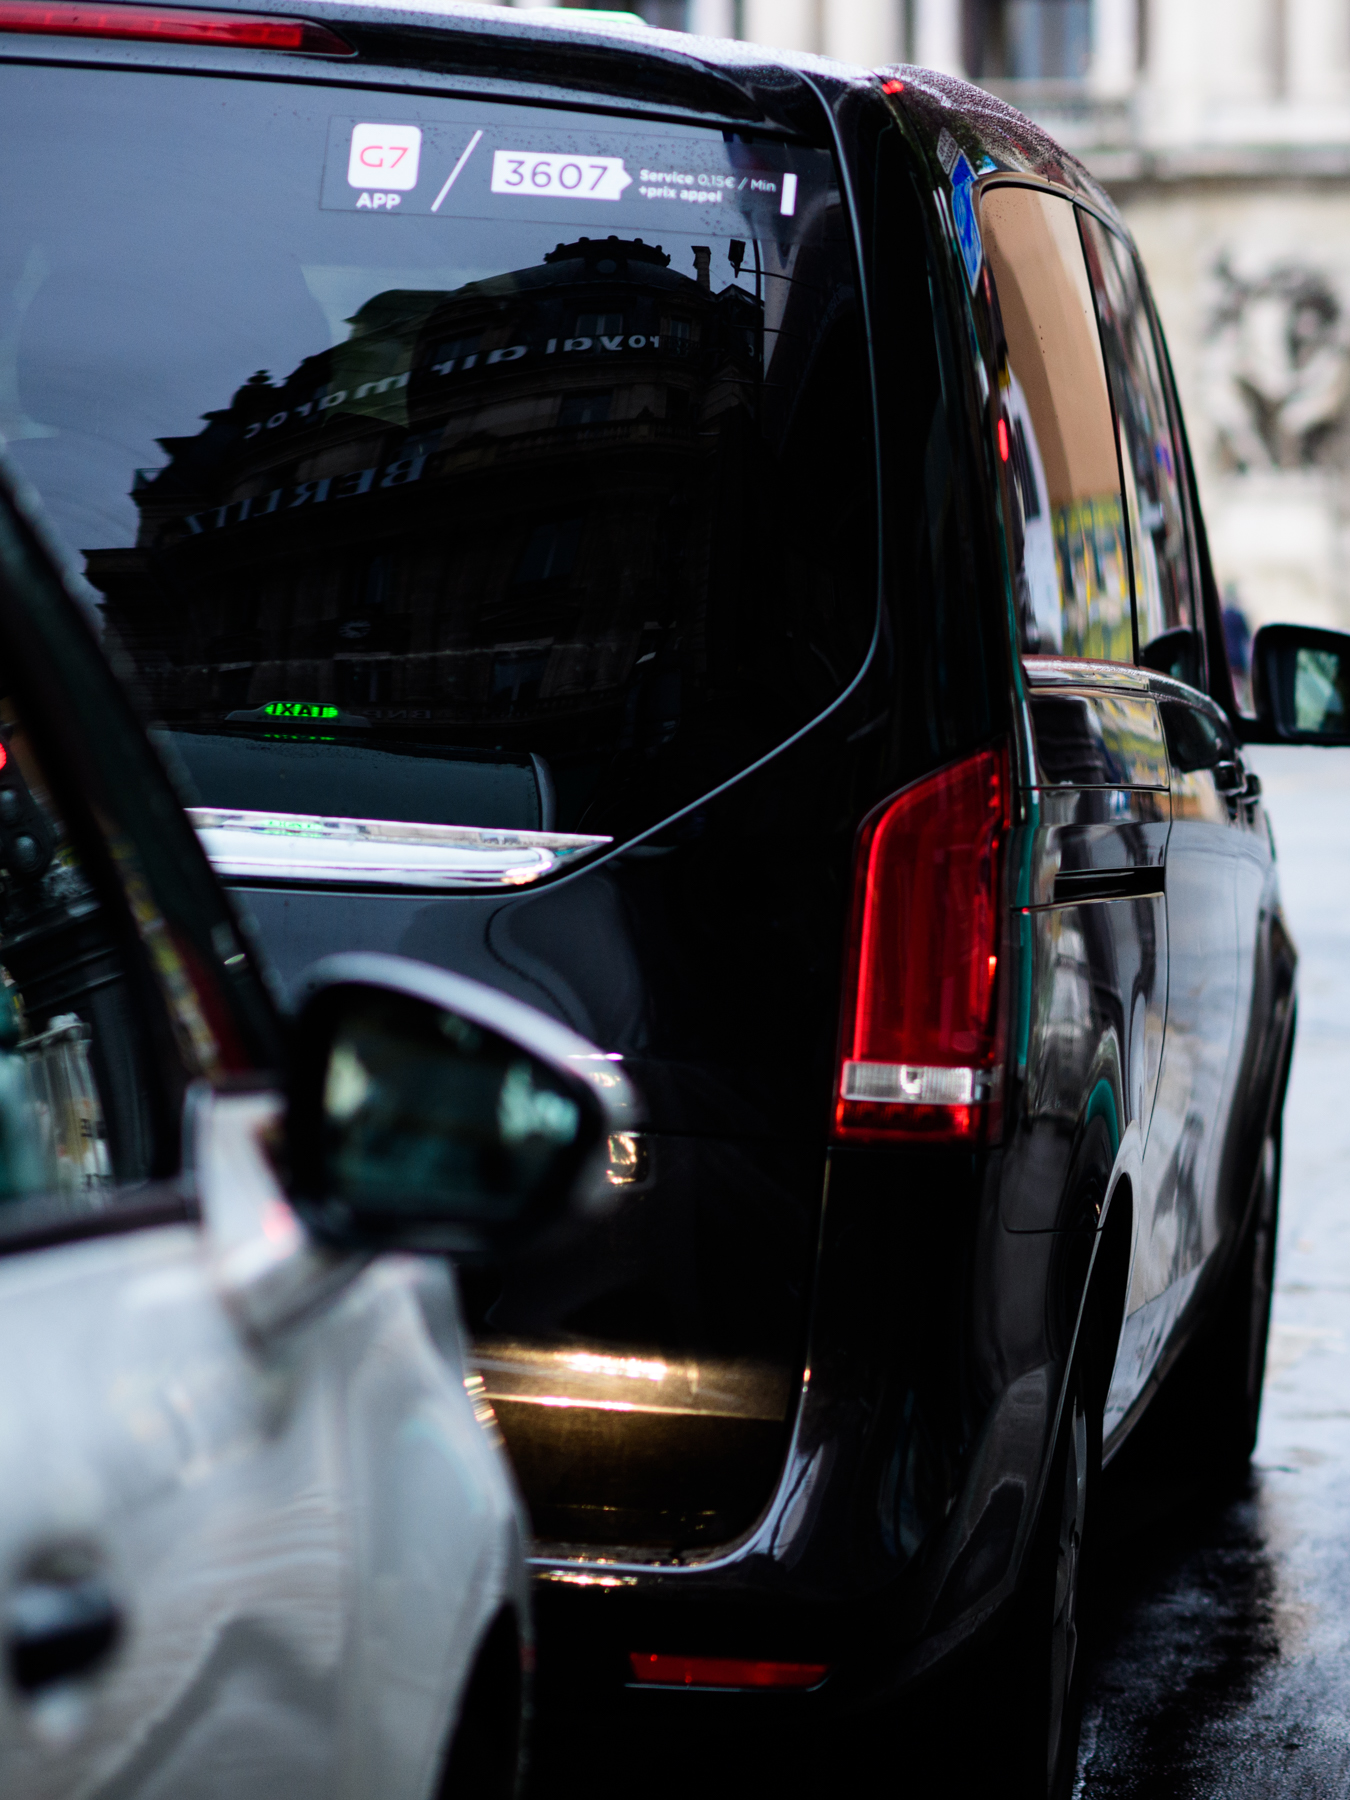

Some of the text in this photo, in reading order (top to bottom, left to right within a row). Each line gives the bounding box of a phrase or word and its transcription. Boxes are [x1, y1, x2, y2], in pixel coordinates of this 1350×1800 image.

[359, 145, 409, 170] G7
[504, 158, 610, 193] 3607
[639, 168, 777, 193] Service 0,15€ Min
[355, 192, 402, 210] APP
[680, 188, 723, 204] appel
